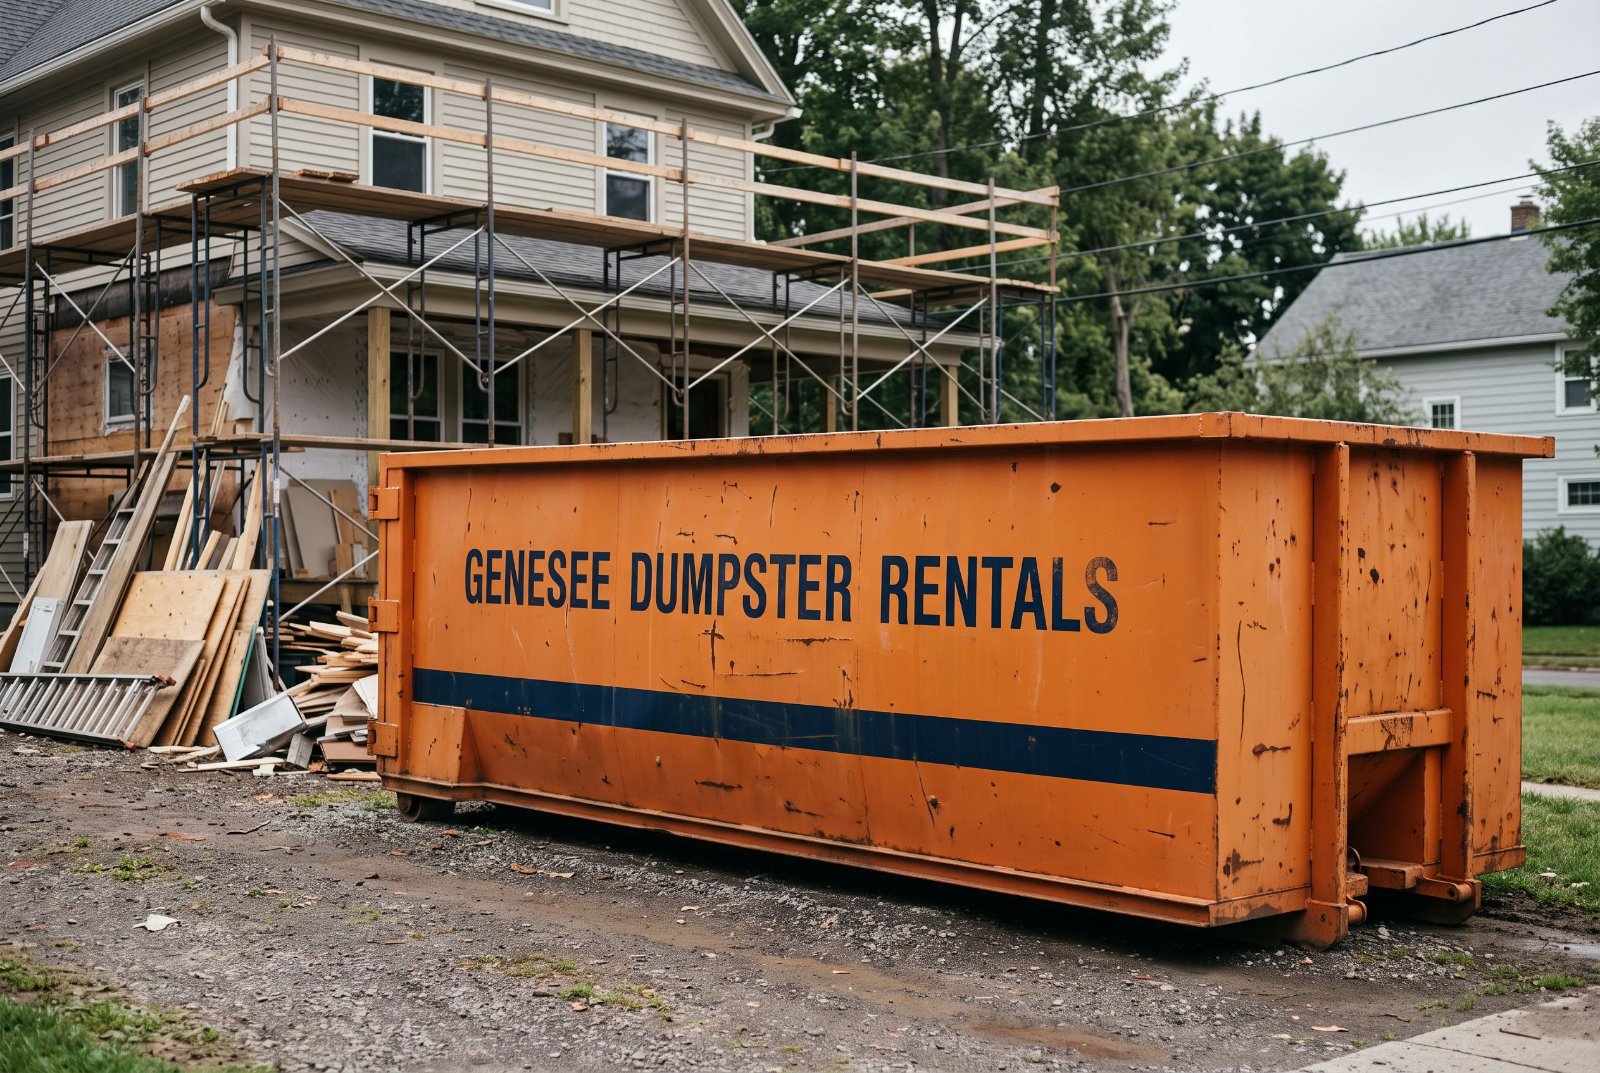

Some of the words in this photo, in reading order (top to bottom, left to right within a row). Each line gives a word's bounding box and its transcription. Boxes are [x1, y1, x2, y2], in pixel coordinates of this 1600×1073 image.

[465, 548, 611, 610] GENESEE
[631, 552, 852, 622] DUMPSTER
[881, 555, 1119, 635] RENTALS
